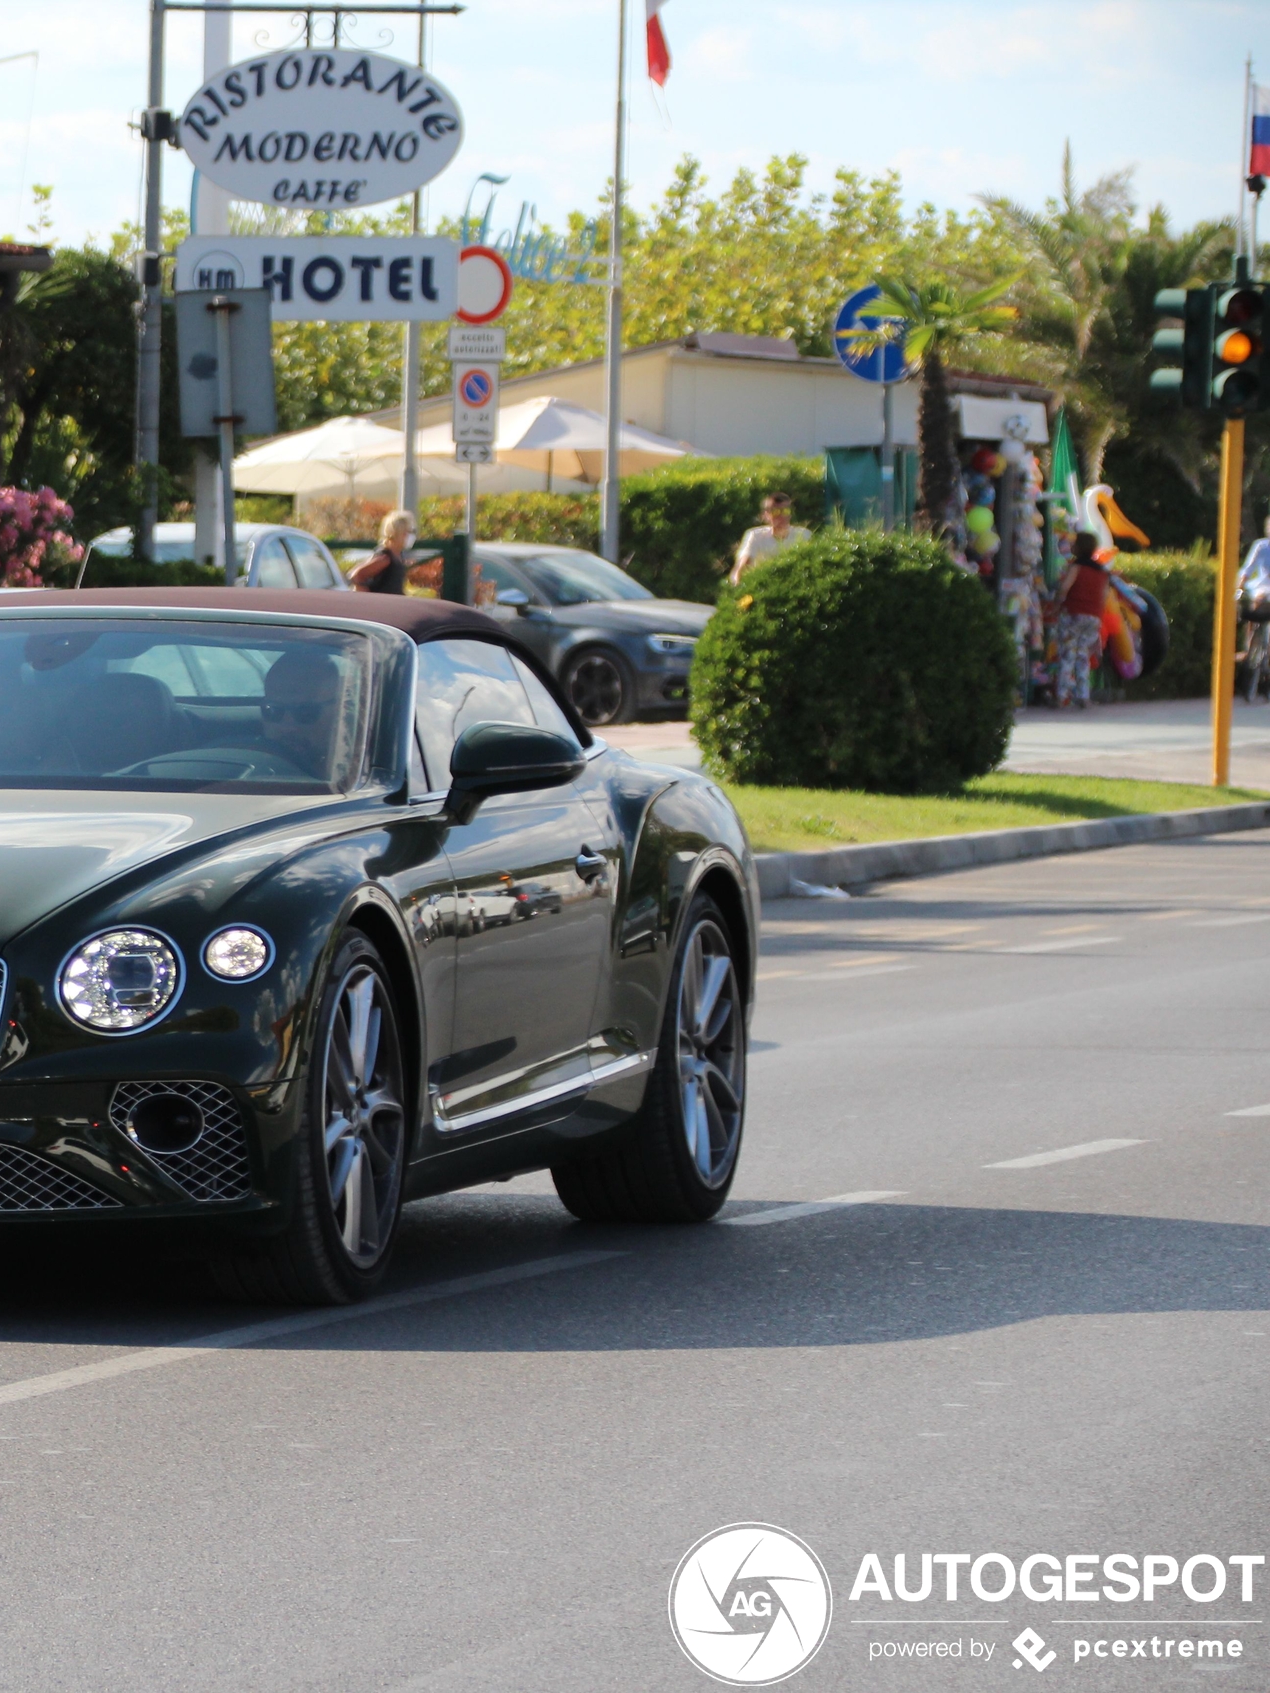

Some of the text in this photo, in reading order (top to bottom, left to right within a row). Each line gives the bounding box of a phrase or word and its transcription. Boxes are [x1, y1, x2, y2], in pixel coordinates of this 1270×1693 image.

[184, 54, 460, 142] RISTORANTE
[213, 131, 419, 164] MODERNO
[262, 255, 439, 302] HOTEL
